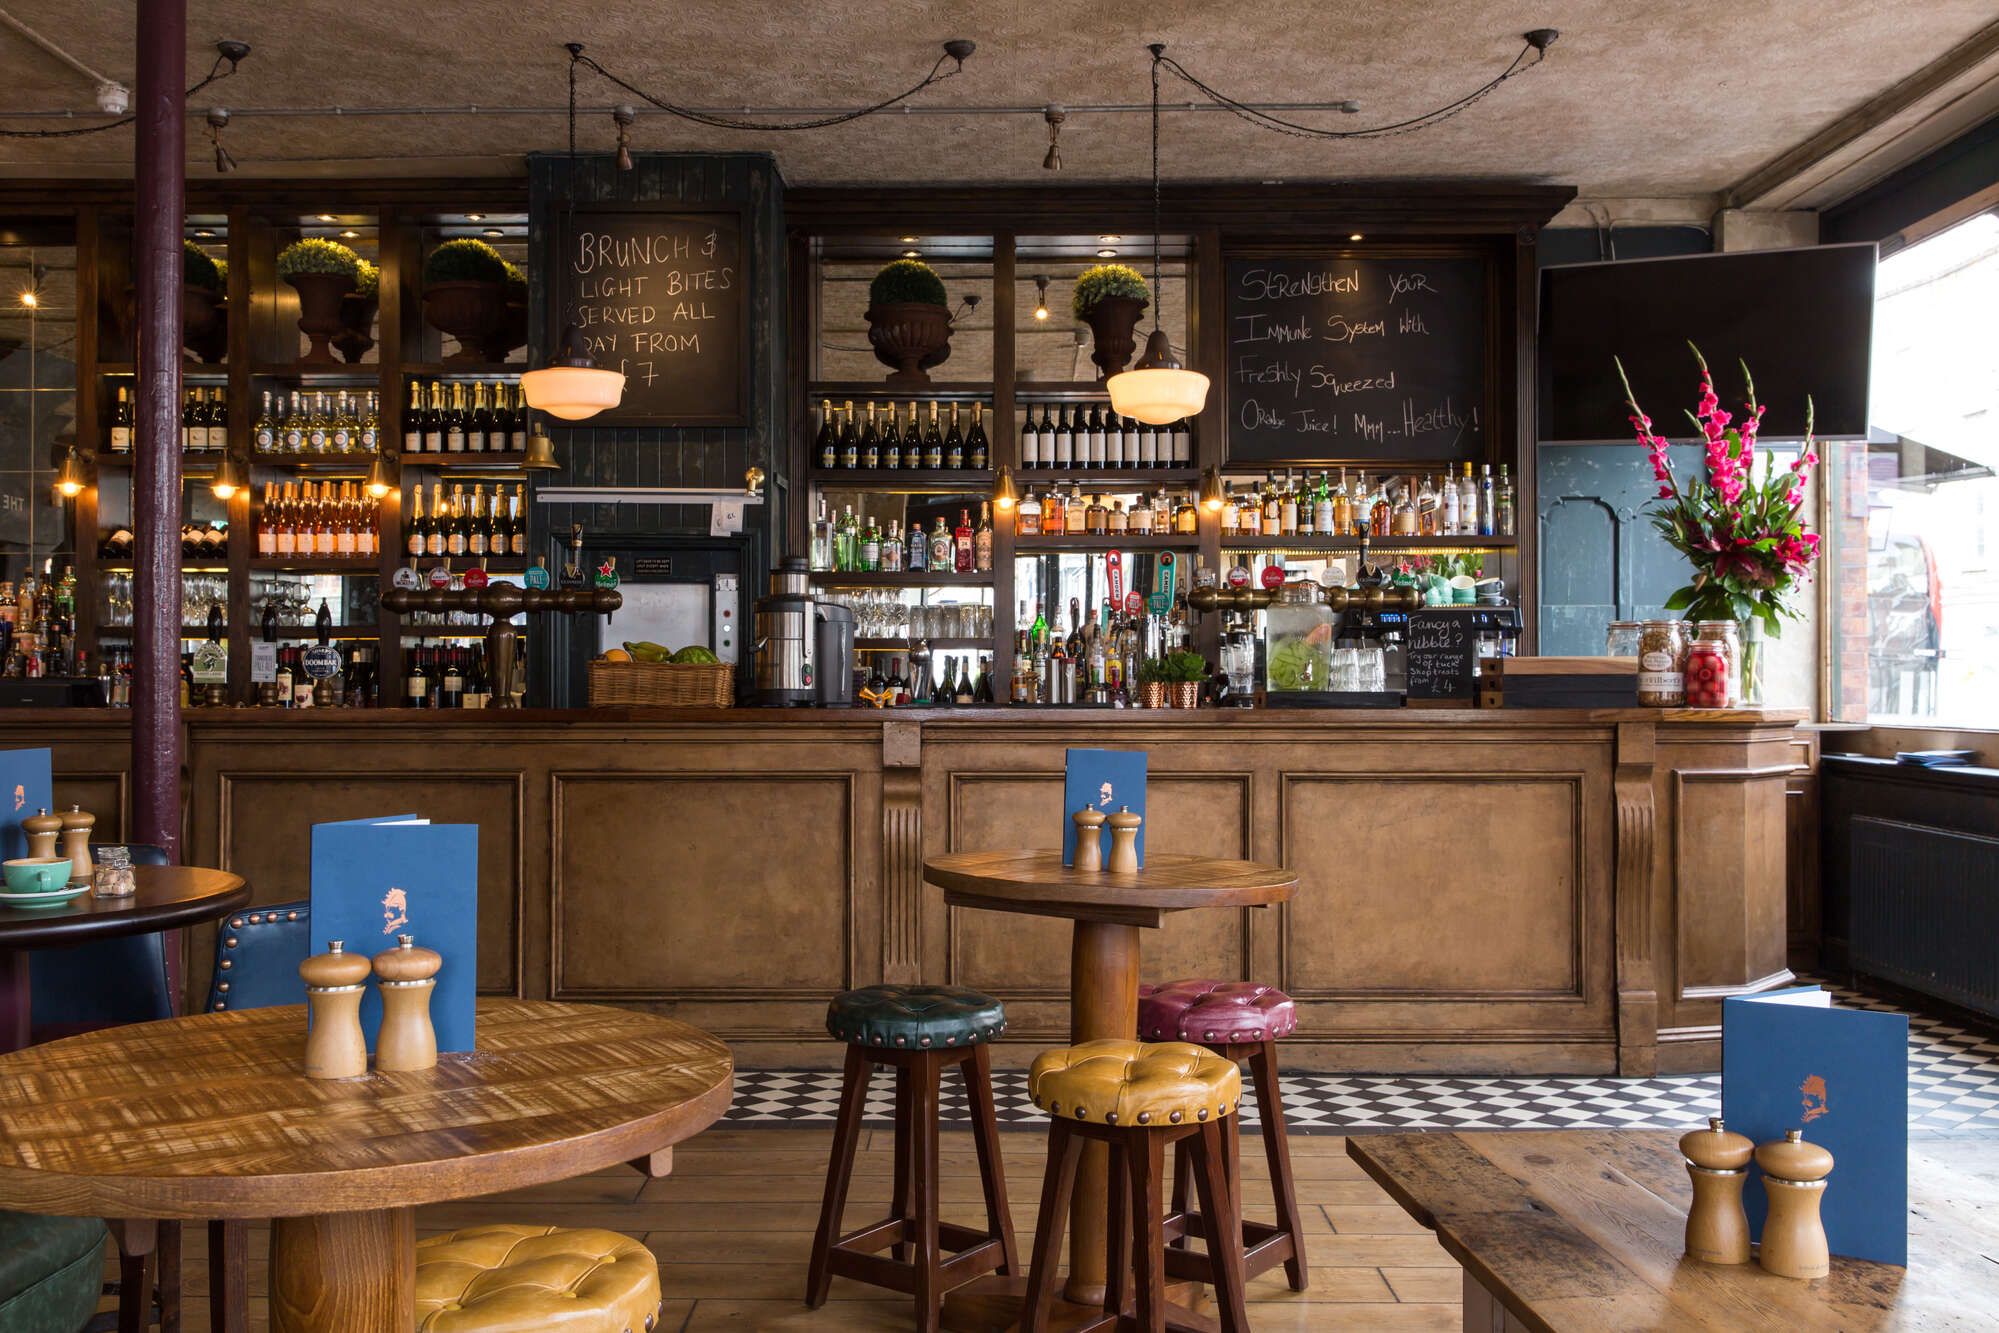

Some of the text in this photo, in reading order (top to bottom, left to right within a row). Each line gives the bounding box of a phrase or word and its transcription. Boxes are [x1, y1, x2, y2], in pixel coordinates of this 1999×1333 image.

[574, 232, 689, 274] BRUNCH
[581, 268, 733, 299] LIGHT BITES
[578, 302, 716, 328] SERVED ALL
[631, 332, 701, 353] FROM
[1408, 615, 1461, 639] Fancy a
[1408, 652, 1464, 664] Try our range
